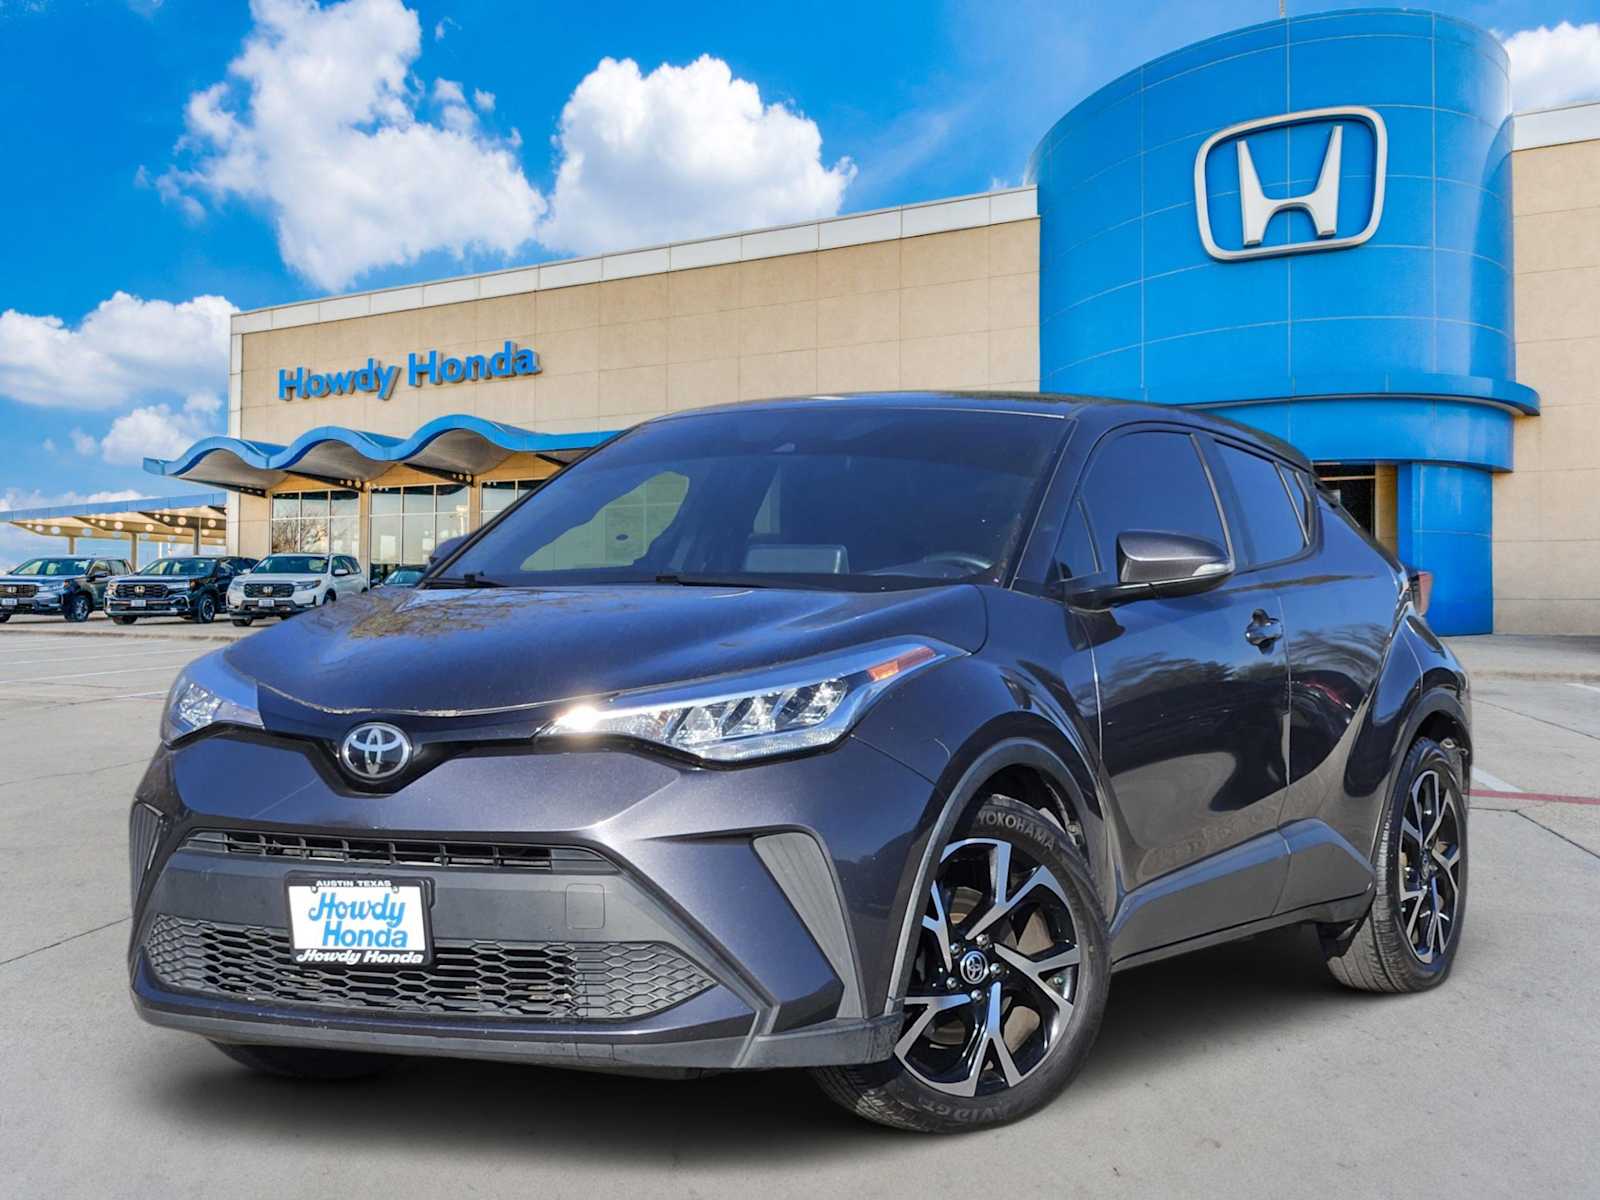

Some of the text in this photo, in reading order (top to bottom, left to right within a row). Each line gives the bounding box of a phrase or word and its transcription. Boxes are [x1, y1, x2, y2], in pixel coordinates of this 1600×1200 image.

[278, 341, 542, 401] Howdy Honda
[977, 810, 1056, 851] YOKOHAMA
[308, 892, 406, 928] Howdy
[322, 920, 408, 948] Honda
[296, 949, 424, 965] Howdy Honda
